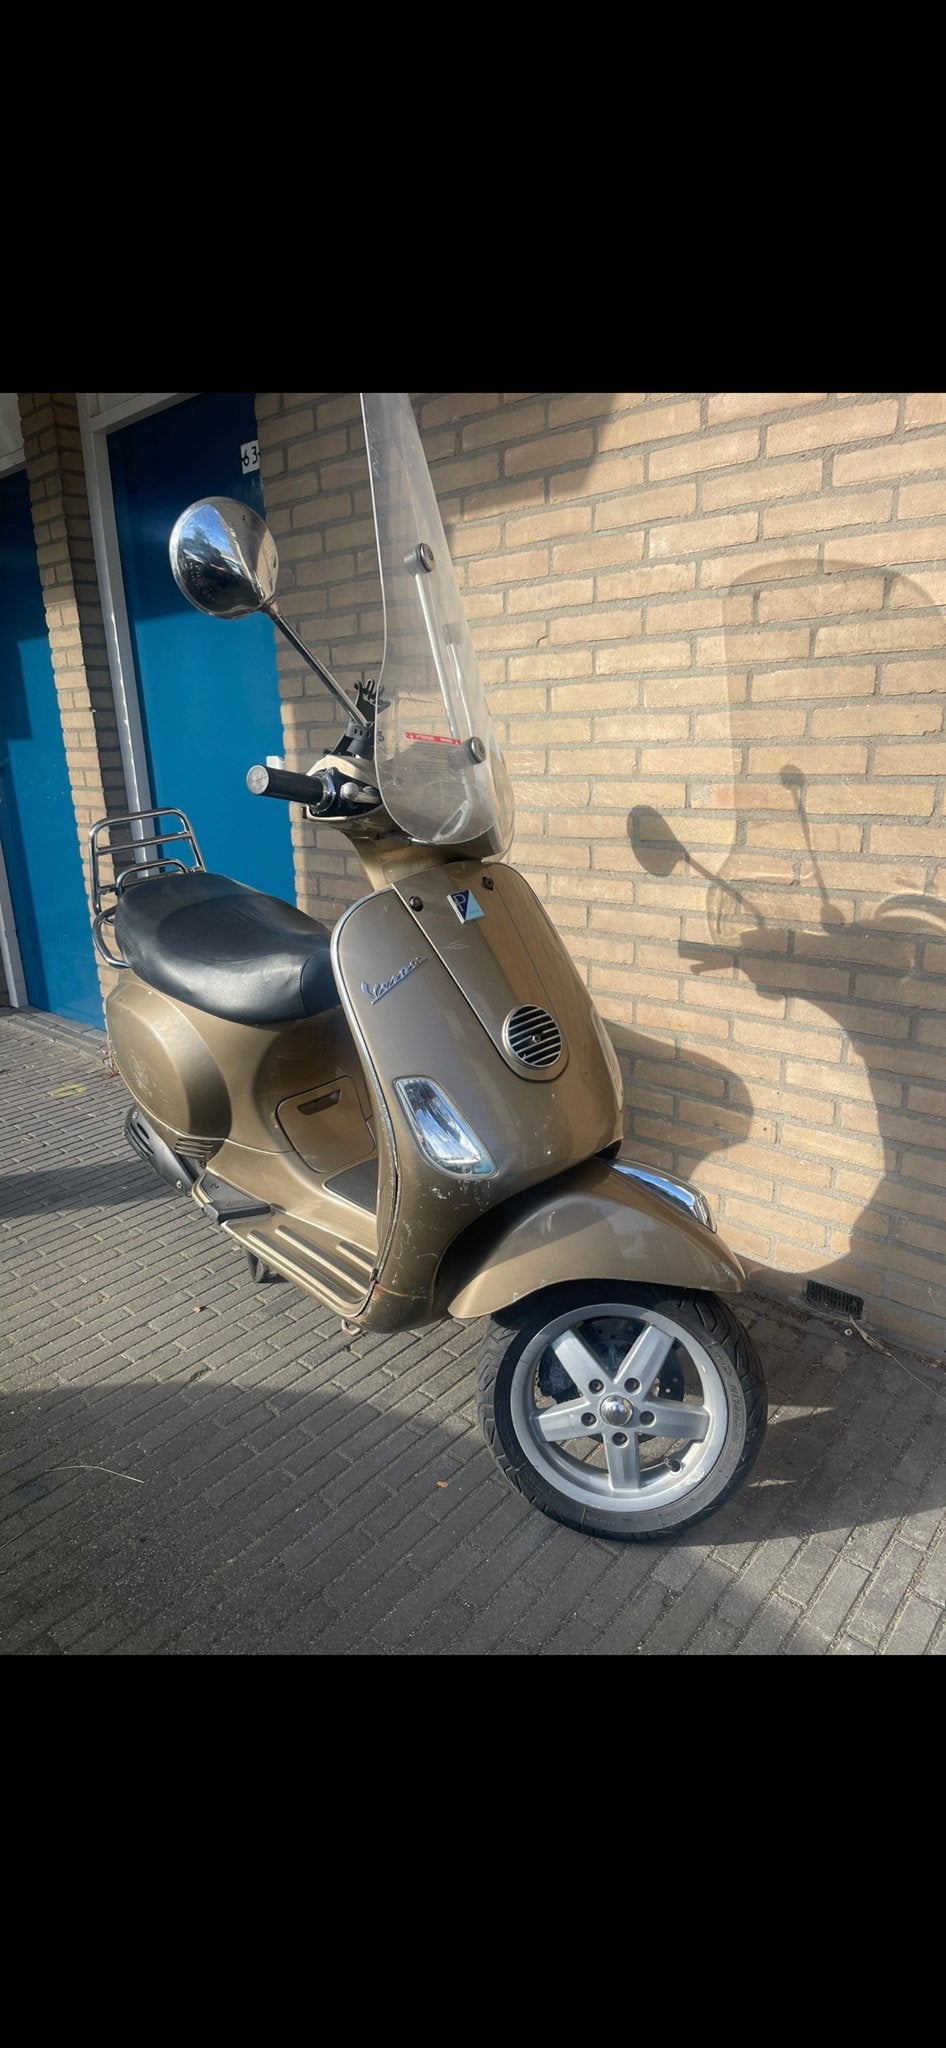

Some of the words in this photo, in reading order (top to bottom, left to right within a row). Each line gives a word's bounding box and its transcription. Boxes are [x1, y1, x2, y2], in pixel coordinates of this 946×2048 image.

[244, 446, 258, 467] 63
[452, 894, 467, 911] P
[361, 957, 428, 1005] Vespa
